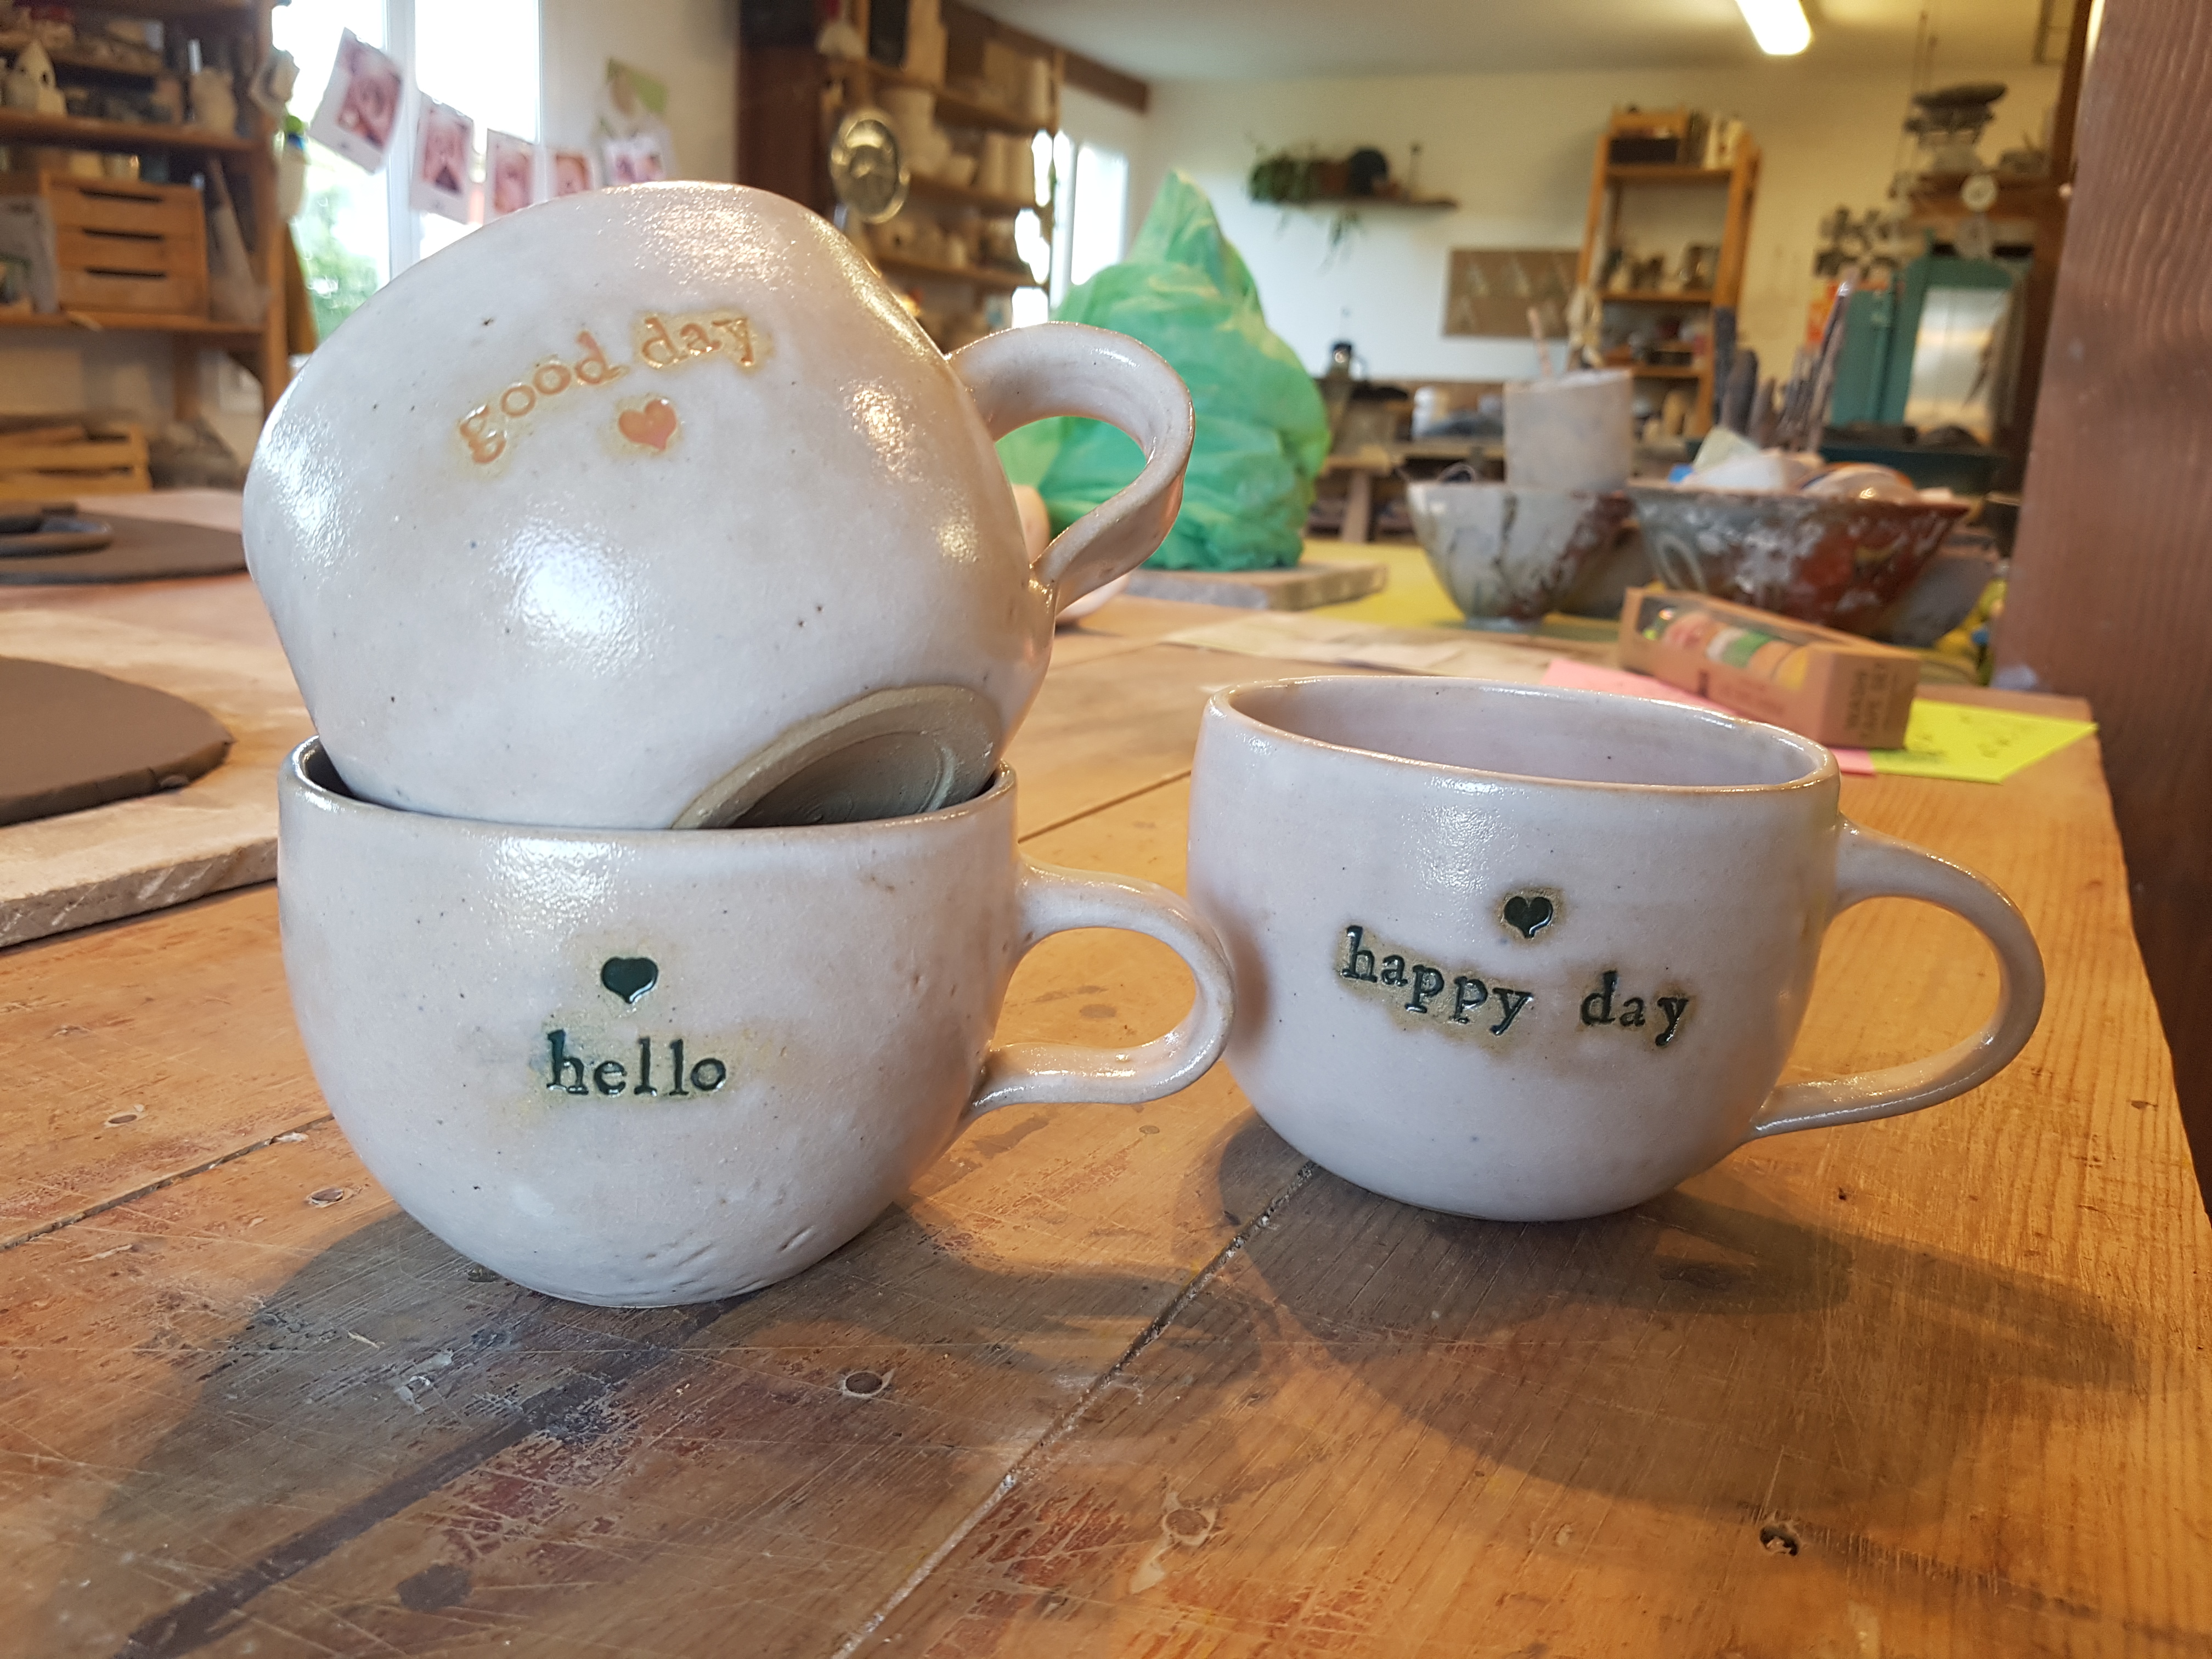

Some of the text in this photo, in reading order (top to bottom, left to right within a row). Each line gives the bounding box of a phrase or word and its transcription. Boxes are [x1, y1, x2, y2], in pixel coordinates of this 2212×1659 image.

[459, 315, 756, 464] good day
[1340, 925, 1690, 1047] happy day
[546, 1029, 727, 1097] hello
